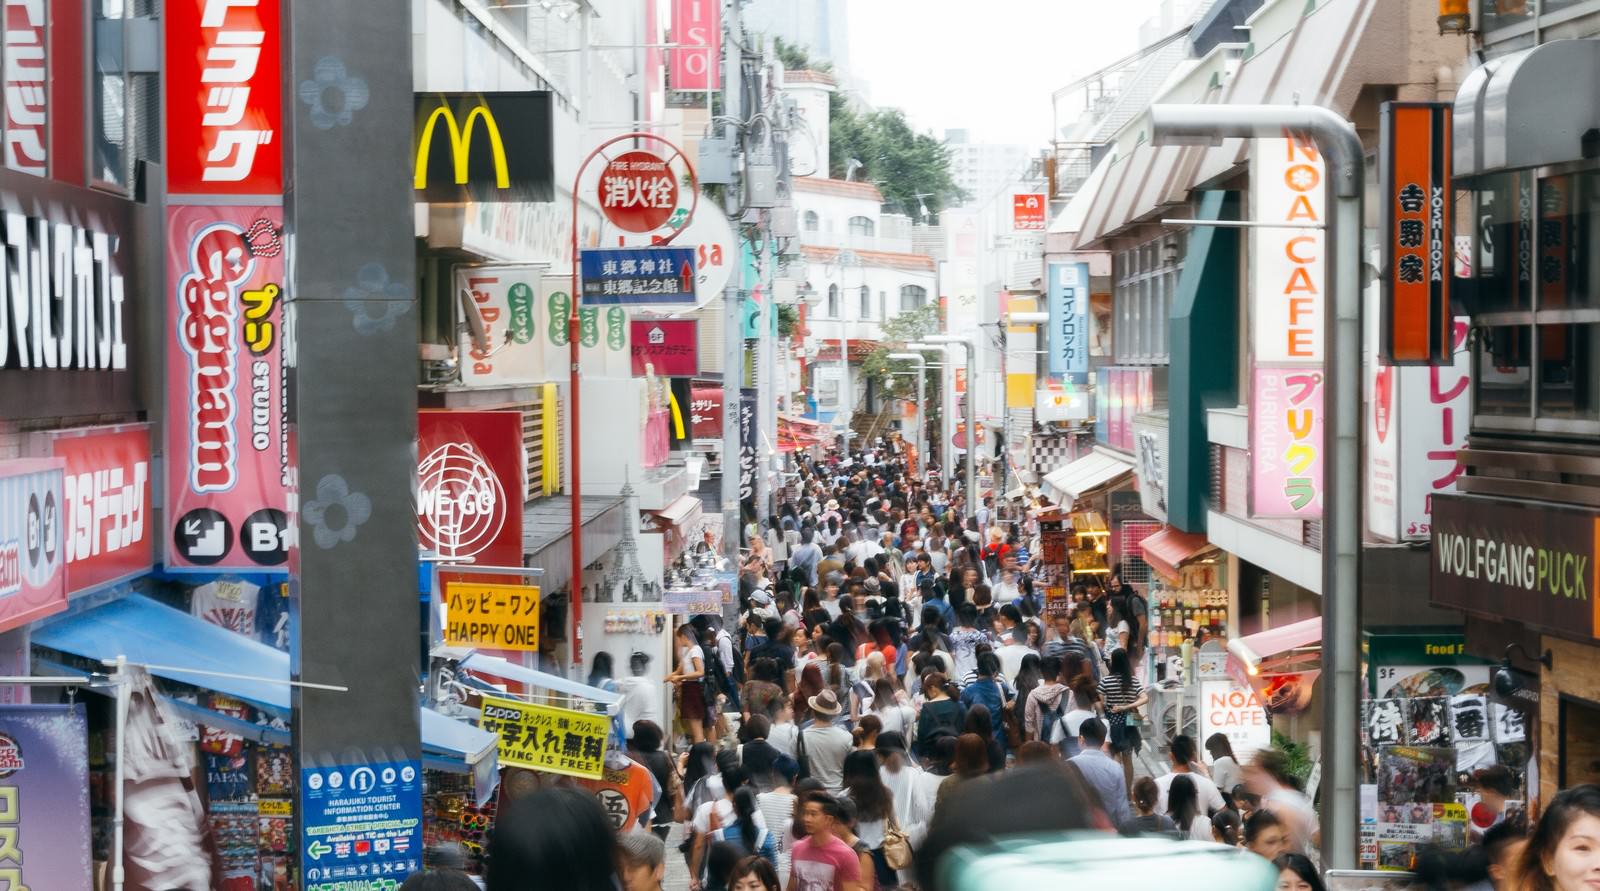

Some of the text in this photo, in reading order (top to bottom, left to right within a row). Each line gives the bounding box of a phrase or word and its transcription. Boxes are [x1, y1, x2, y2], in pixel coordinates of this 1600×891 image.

[610, 161, 666, 172] FIRE HYDRANT
[1284, 133, 1320, 222] NOA
[603, 175, 674, 209] 消火栓
[1399, 182, 1425, 284] 吉野家
[602, 258, 674, 276] 東郷神社
[602, 278, 678, 295] 東郷記念館
[1283, 236, 1318, 356] CAFE
[242, 283, 279, 354] プリ
[1062, 287, 1075, 371] コインロッカー
[253, 361, 270, 451] STUDIO
[1427, 322, 1469, 490] レープ
[1260, 375, 1278, 473] PURIKURA
[1284, 373, 1322, 511] プリクラ
[449, 591, 537, 617] ハッピーワン
[448, 621, 536, 646] HAPPY ONE
[1425, 643, 1454, 655] Food
[1379, 668, 1396, 679] 3F
[1210, 691, 1264, 708] NOA
[1209, 710, 1265, 727] CAFE
[540, 754, 554, 764] IS
[323, 802, 401, 816] INFORMATION CENTER
[328, 794, 397, 807] HARAJUKU TOURIST
